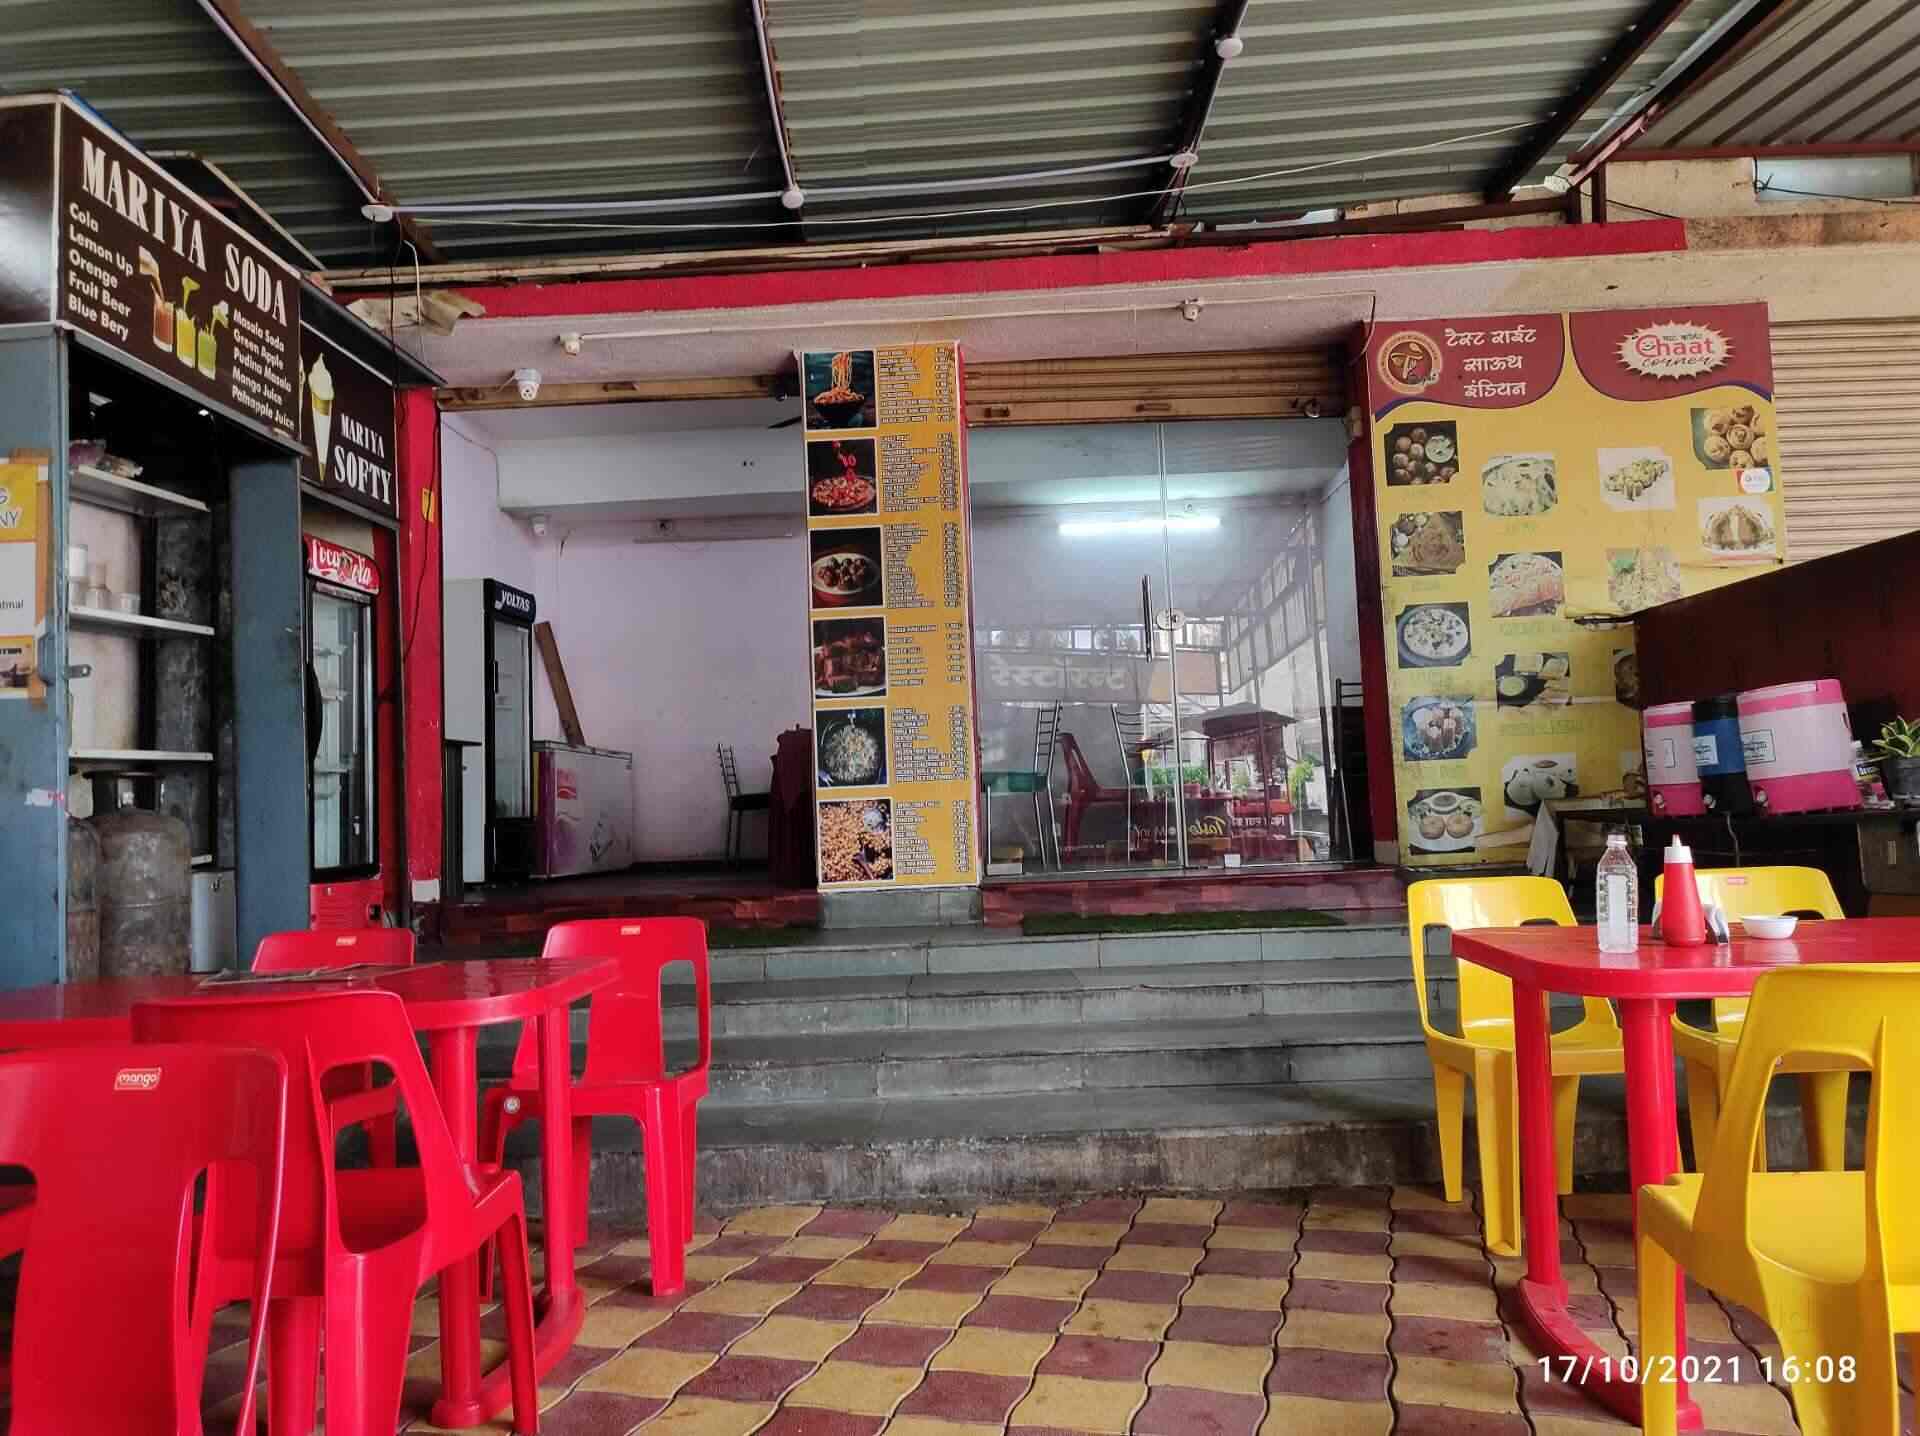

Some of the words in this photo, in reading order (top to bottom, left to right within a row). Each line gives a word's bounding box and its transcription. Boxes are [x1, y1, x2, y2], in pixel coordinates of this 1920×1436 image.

[69, 202, 98, 232] Cola
[82, 137, 207, 272] MARIYA
[225, 243, 287, 327] SODA
[69, 223, 113, 263] Lemon
[116, 252, 133, 277] Up
[69, 270, 98, 300] Fruit
[101, 288, 131, 317] Beer
[68, 294, 98, 321] Blue
[101, 310, 129, 341] Bery
[233, 308, 263, 339] Masala
[265, 329, 284, 353] Soda
[233, 328, 259, 354] Green
[1634, 334, 1713, 358] Chaat
[232, 365, 261, 394] Mango
[341, 413, 385, 459] MARIYA
[334, 445, 392, 505] SOFTY
[495, 589, 530, 612] VOLTAS
[119, 1073, 157, 1088] mango
